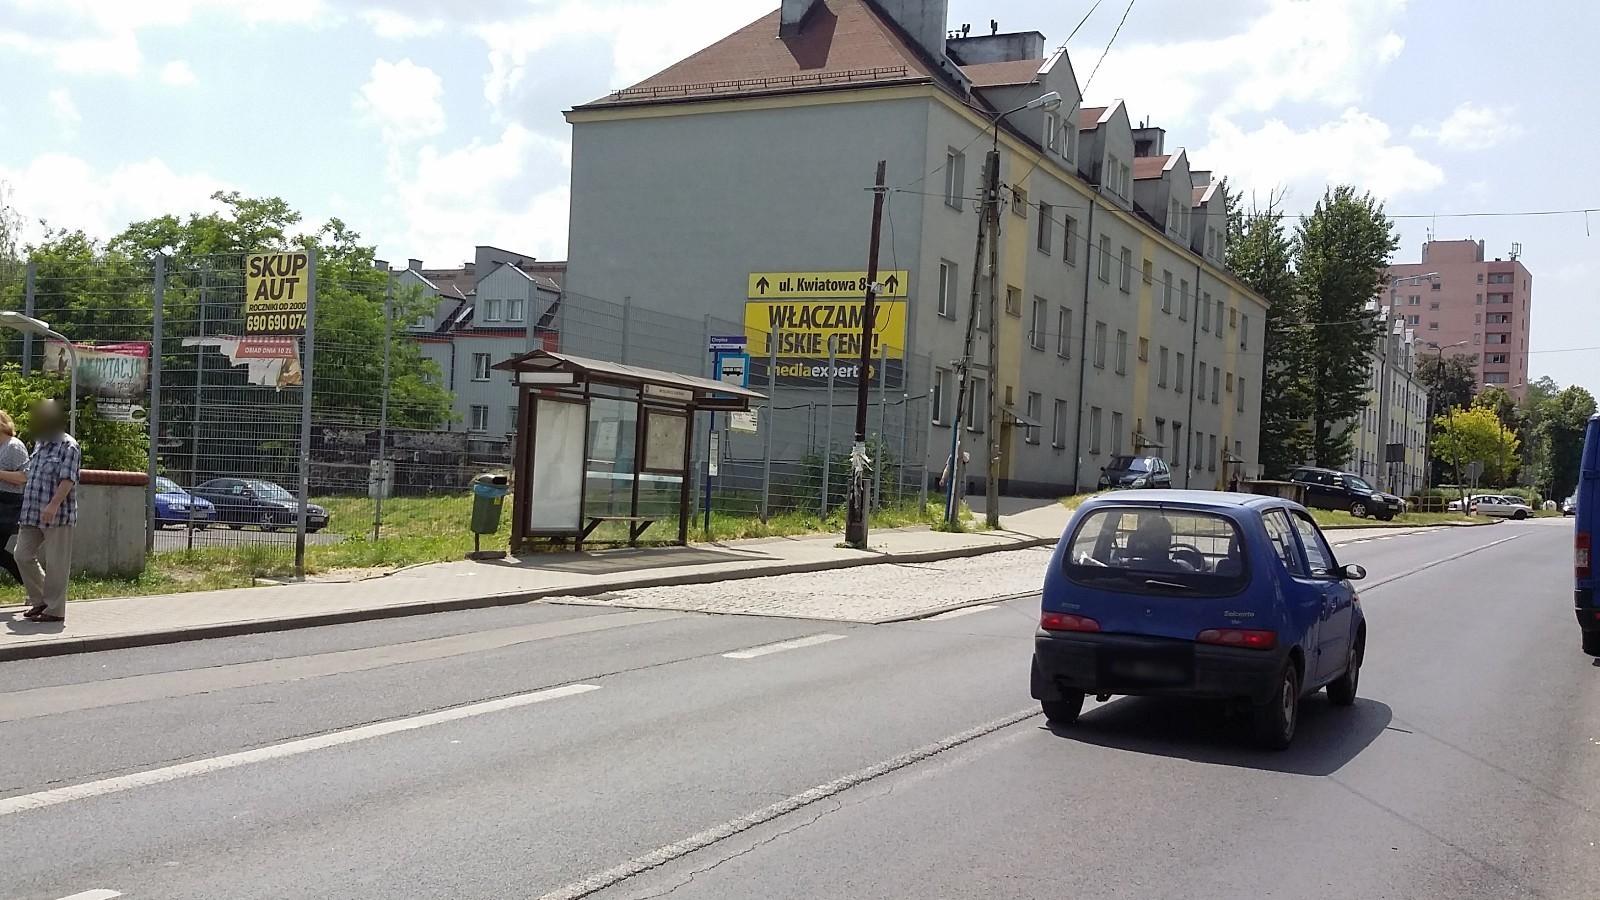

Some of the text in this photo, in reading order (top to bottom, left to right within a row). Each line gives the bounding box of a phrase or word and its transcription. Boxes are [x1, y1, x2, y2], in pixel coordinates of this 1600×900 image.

[249, 254, 307, 278] SKUP
[254, 278, 300, 301] AUT
[779, 277, 794, 292] ul.
[797, 277, 856, 292] Kwiatowa
[249, 302, 306, 312] ROCZNIKI OD 2000
[246, 313, 307, 331] 690 690 074
[827, 333, 879, 354] CEN!
